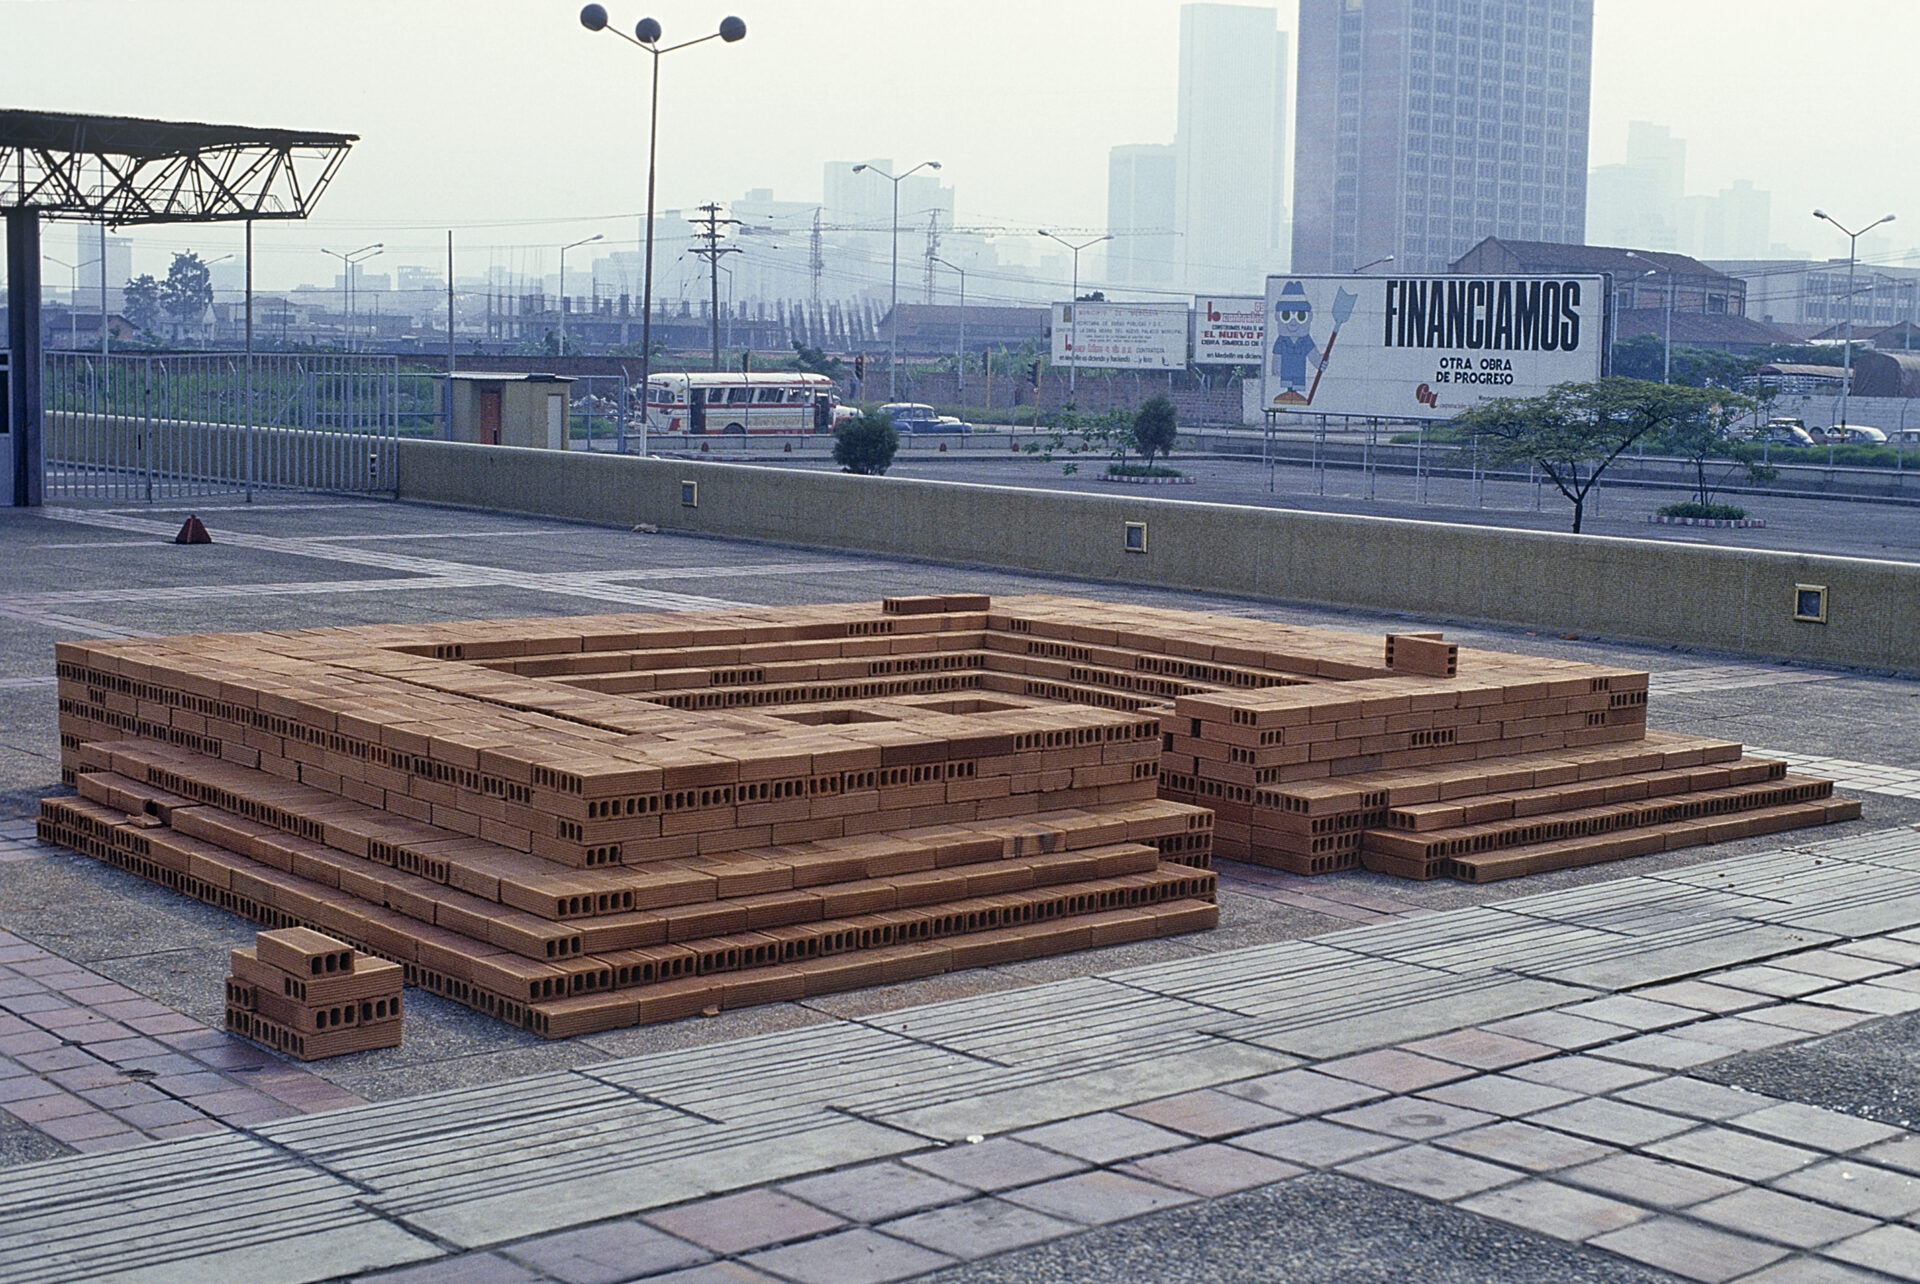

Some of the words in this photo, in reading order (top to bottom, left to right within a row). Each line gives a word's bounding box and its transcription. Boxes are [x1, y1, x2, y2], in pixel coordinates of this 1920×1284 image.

[1384, 280, 1581, 351] FINANCIAMOS
[1218, 331, 1254, 339] NUEVO
[1439, 357, 1473, 370] OTRA
[1480, 358, 1513, 371] OBRA
[1435, 371, 1450, 383] DE
[1454, 372, 1514, 385] PROGRESO
